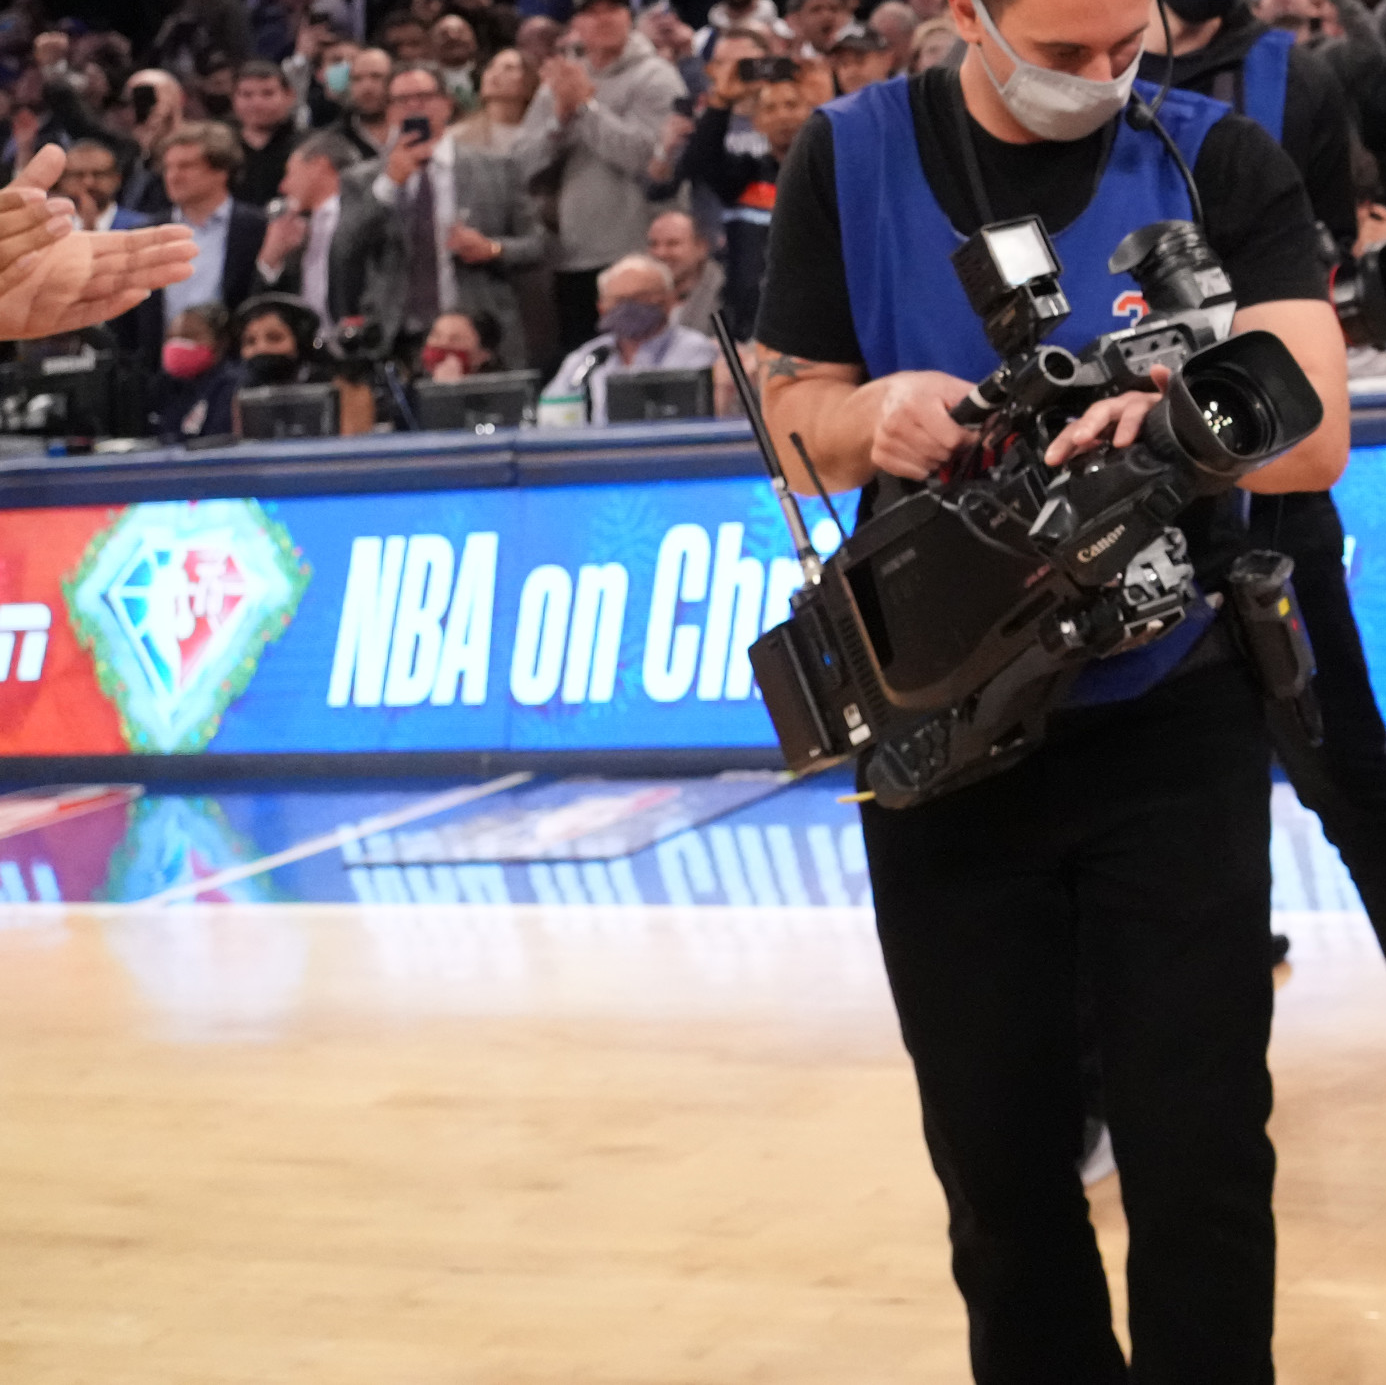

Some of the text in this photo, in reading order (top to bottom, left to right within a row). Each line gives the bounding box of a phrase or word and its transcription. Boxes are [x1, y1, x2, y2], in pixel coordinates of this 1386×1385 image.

[988, 497, 1022, 530] SOY
[1076, 523, 1126, 565] Canon
[327, 531, 499, 707] NBA
[509, 562, 628, 706] on
